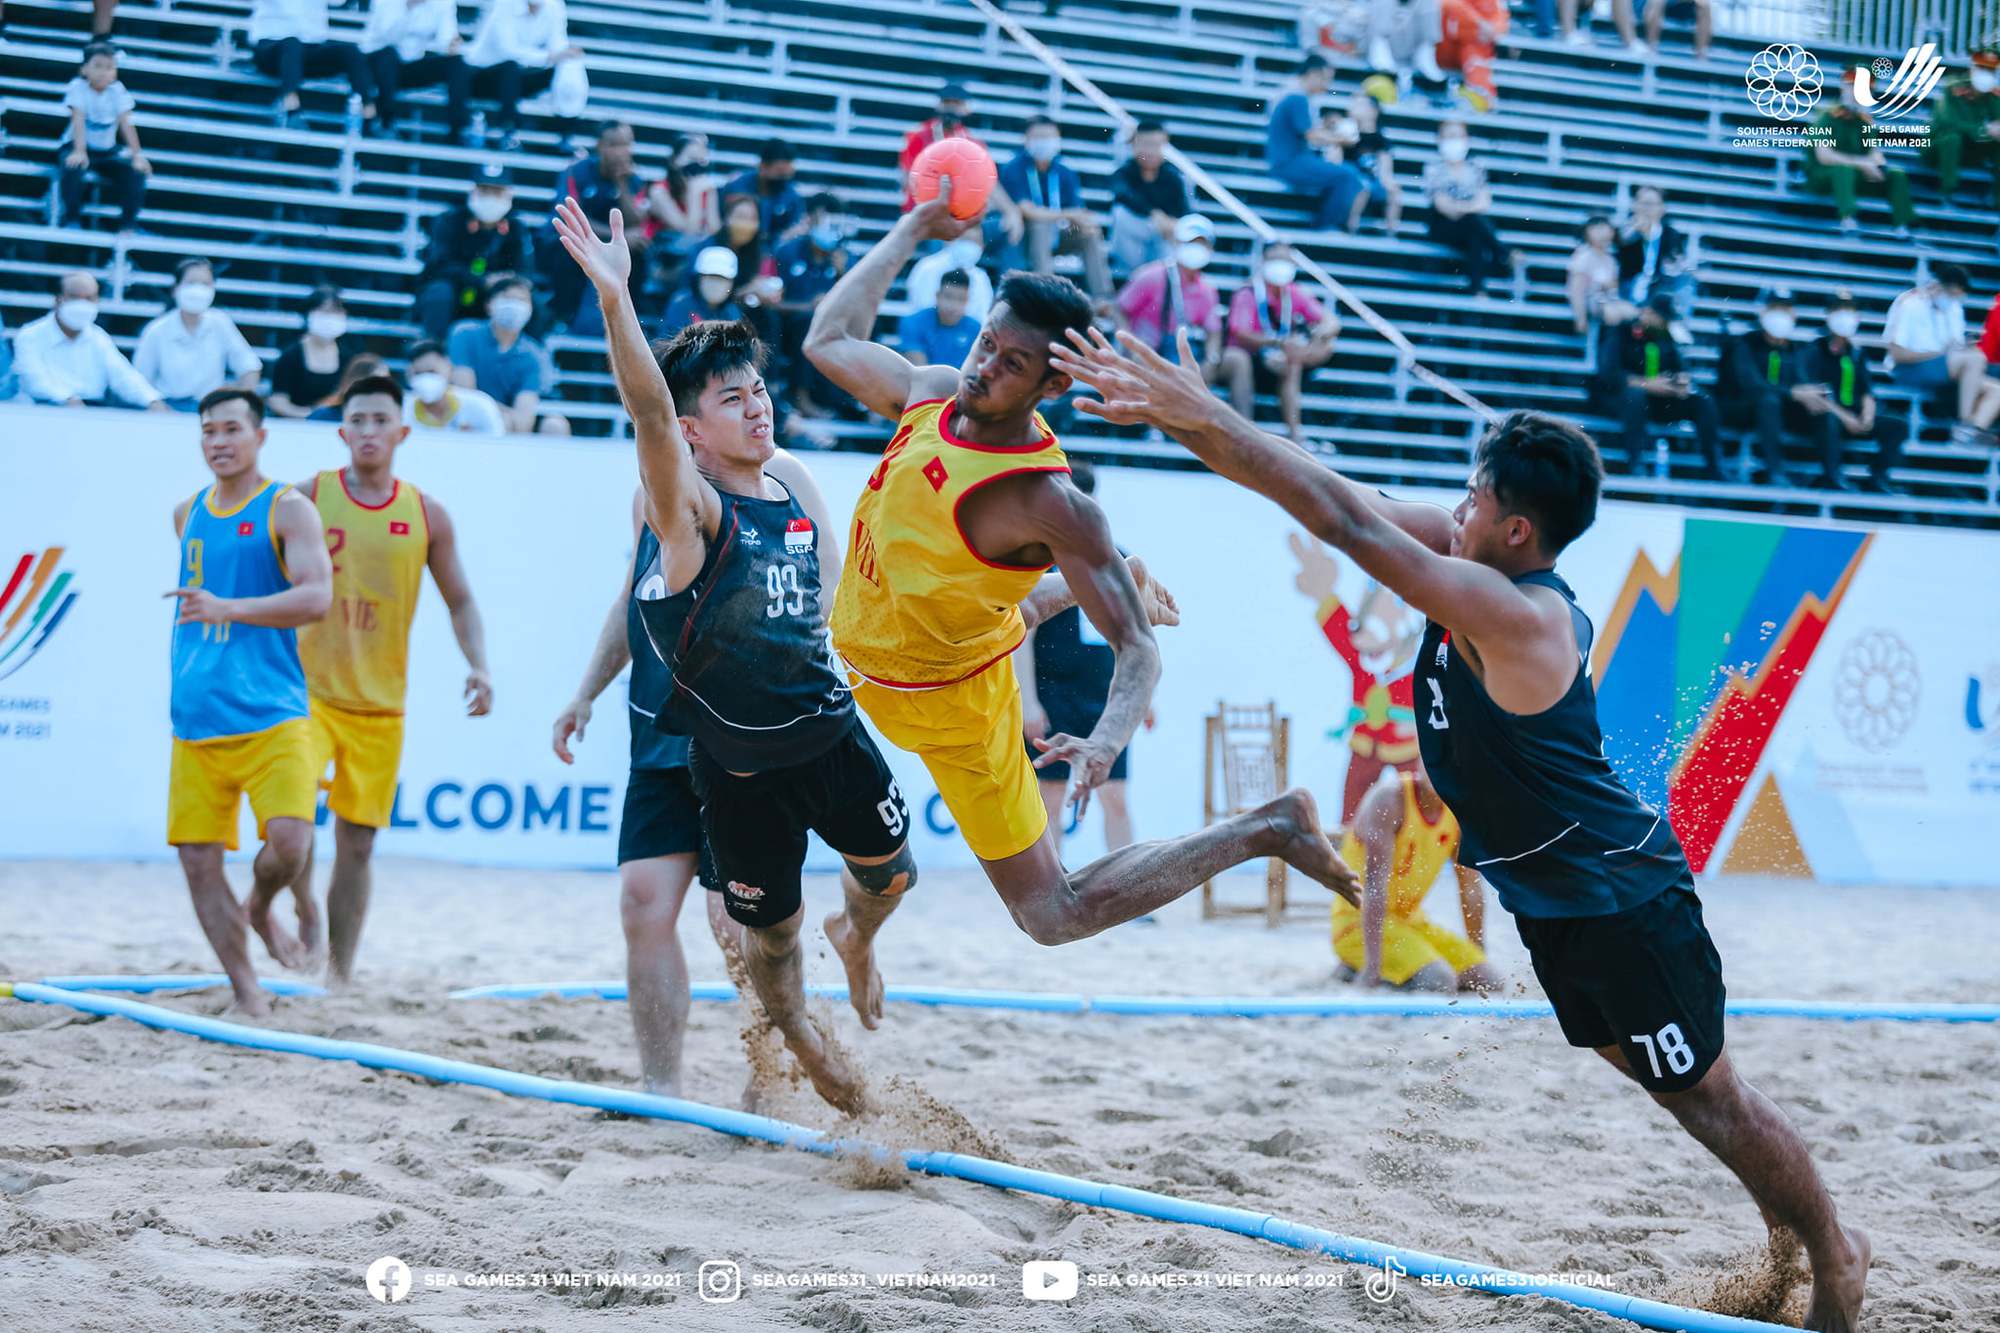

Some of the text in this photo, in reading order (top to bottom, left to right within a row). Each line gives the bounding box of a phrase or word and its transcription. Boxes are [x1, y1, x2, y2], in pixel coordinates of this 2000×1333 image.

[186, 537, 204, 588] 9
[785, 545, 814, 555] SGP
[766, 564, 804, 619] 93
[316, 782, 612, 831] LCOME
[1630, 1022, 1695, 1078] 78
